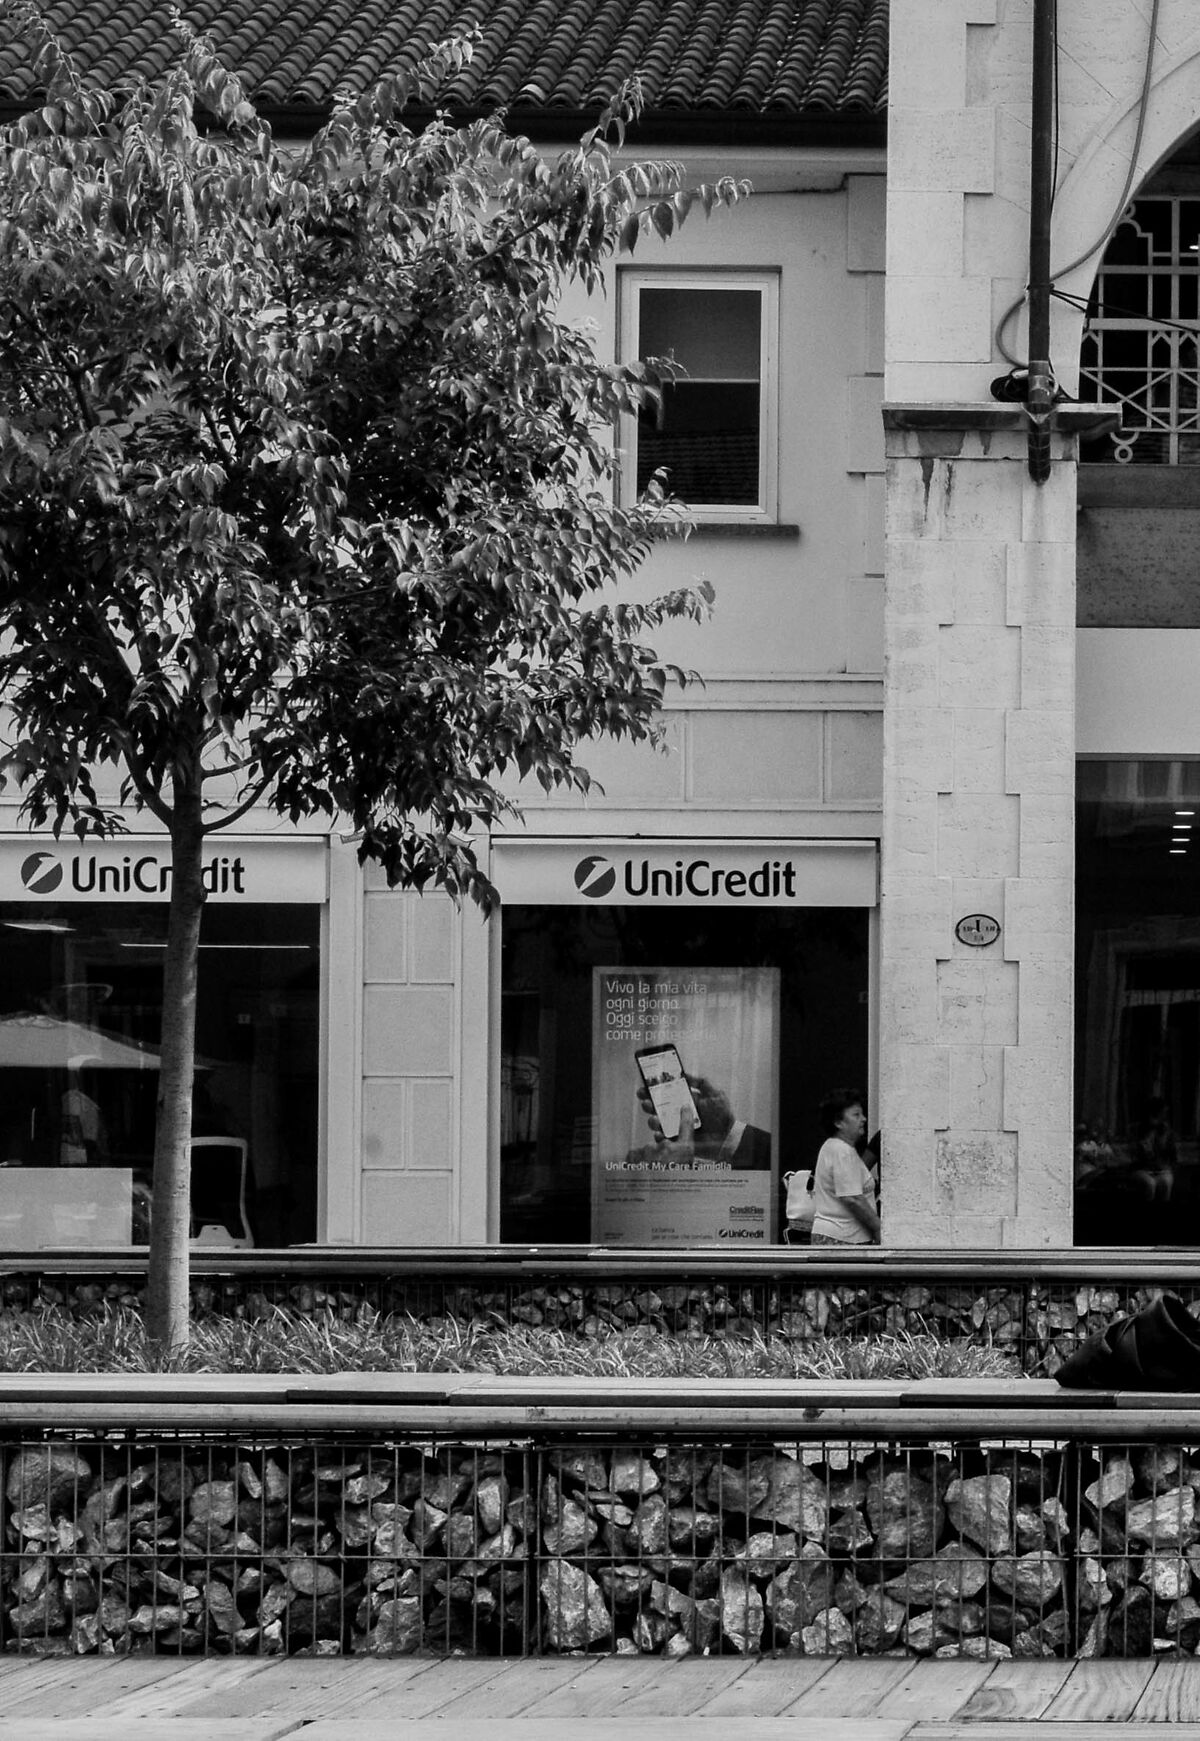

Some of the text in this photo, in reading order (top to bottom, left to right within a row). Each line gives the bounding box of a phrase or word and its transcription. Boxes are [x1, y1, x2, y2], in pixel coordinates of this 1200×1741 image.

[72, 856, 245, 893] UniCrdit
[624, 860, 796, 897] UniCredit
[606, 980, 707, 994] Vivo la mia vita
[606, 996, 634, 1013] ogni
[606, 1011, 635, 1028] Oggi
[606, 1029, 641, 1041] come
[605, 1161, 732, 1173] UniCredit My Care Famiglia
[728, 1229, 765, 1239] UniCredit
